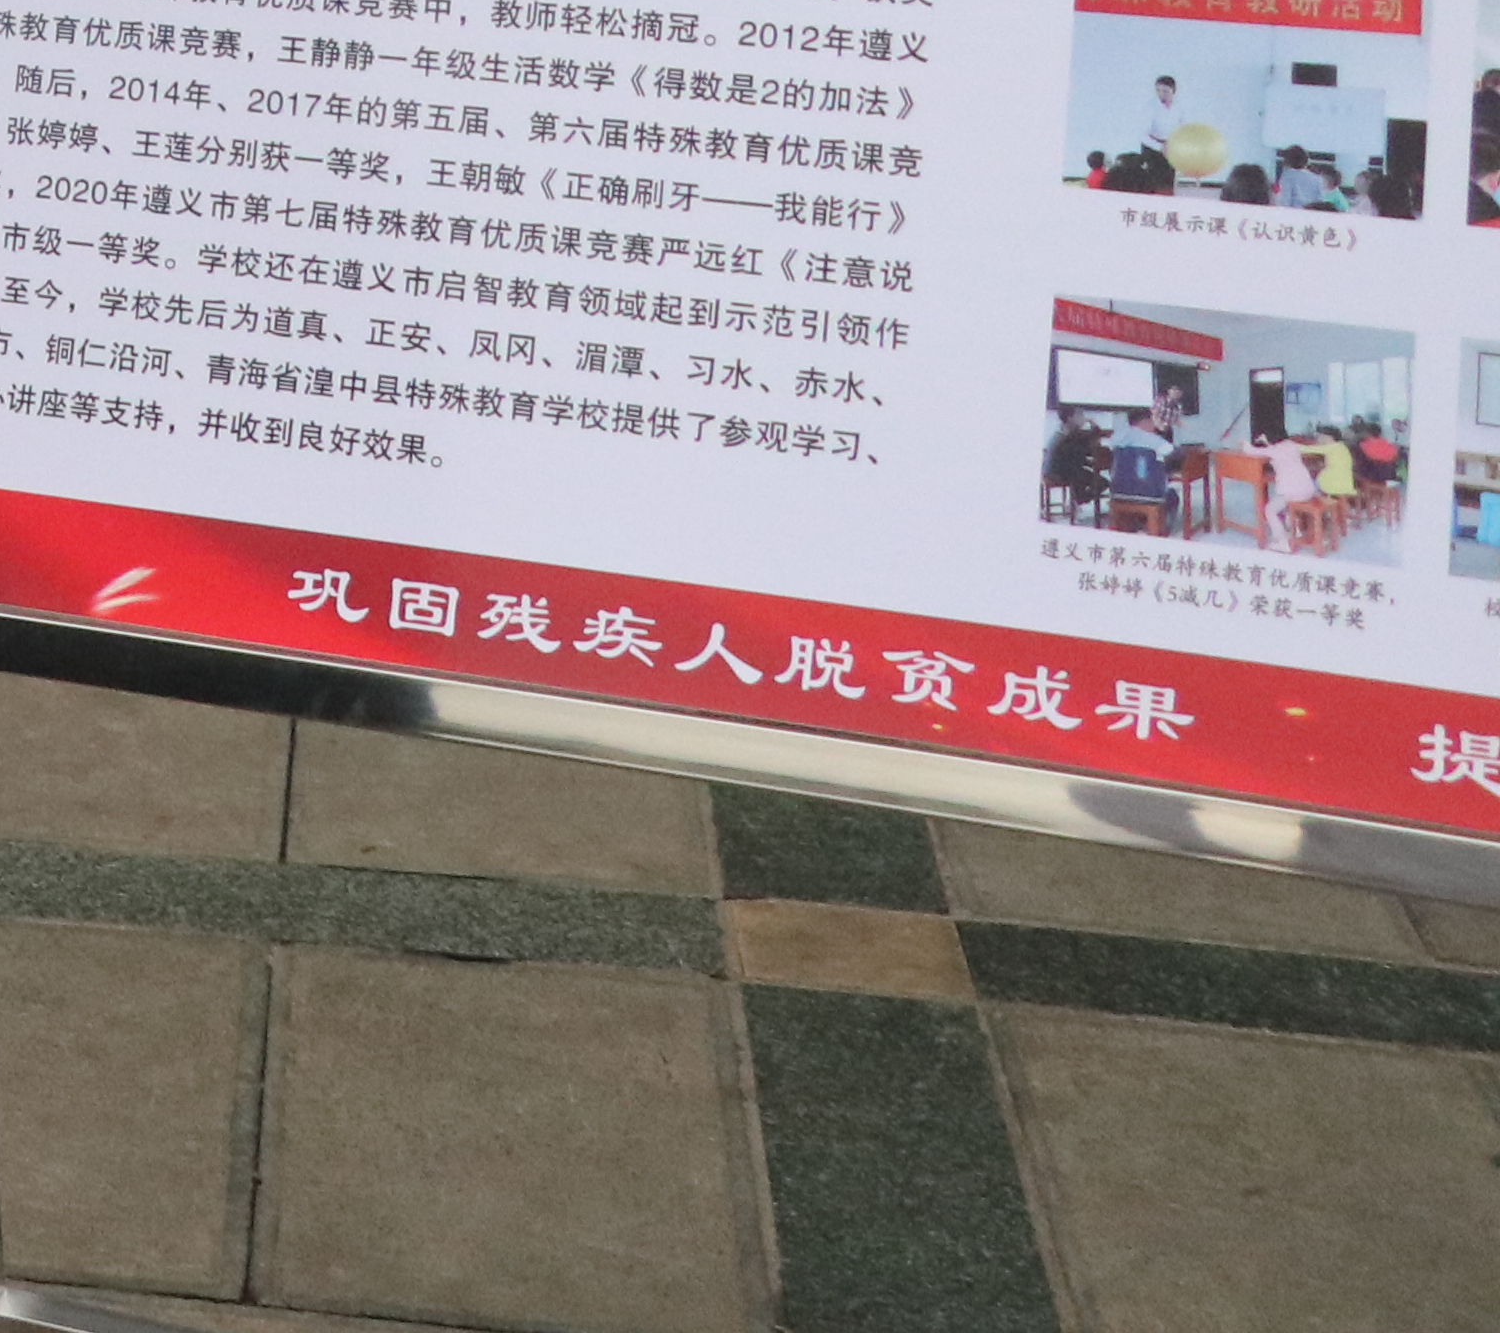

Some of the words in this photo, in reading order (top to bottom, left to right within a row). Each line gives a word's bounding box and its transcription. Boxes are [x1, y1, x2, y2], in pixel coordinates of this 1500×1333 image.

[1119, 207, 1358, 251] 市级展示课《认识黄色》
[287, 565, 1194, 740] 巩固残疾人脱贫成果
